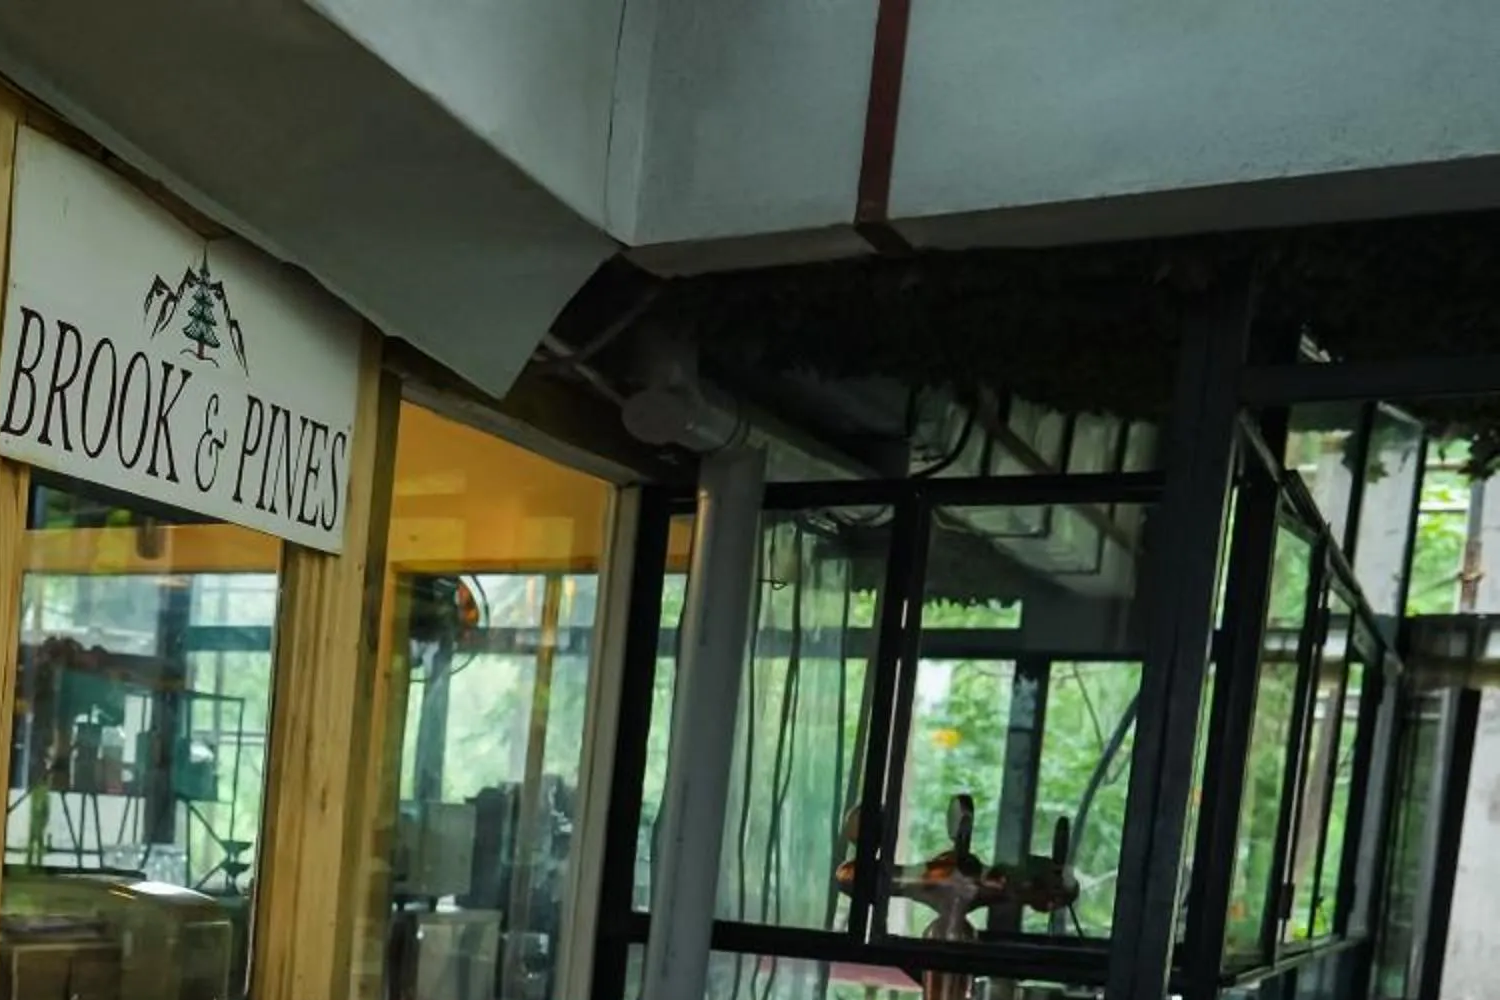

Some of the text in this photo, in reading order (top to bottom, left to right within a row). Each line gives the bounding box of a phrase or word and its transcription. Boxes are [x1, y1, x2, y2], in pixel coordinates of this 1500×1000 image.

[0, 305, 347, 532] BROOK & PINES
